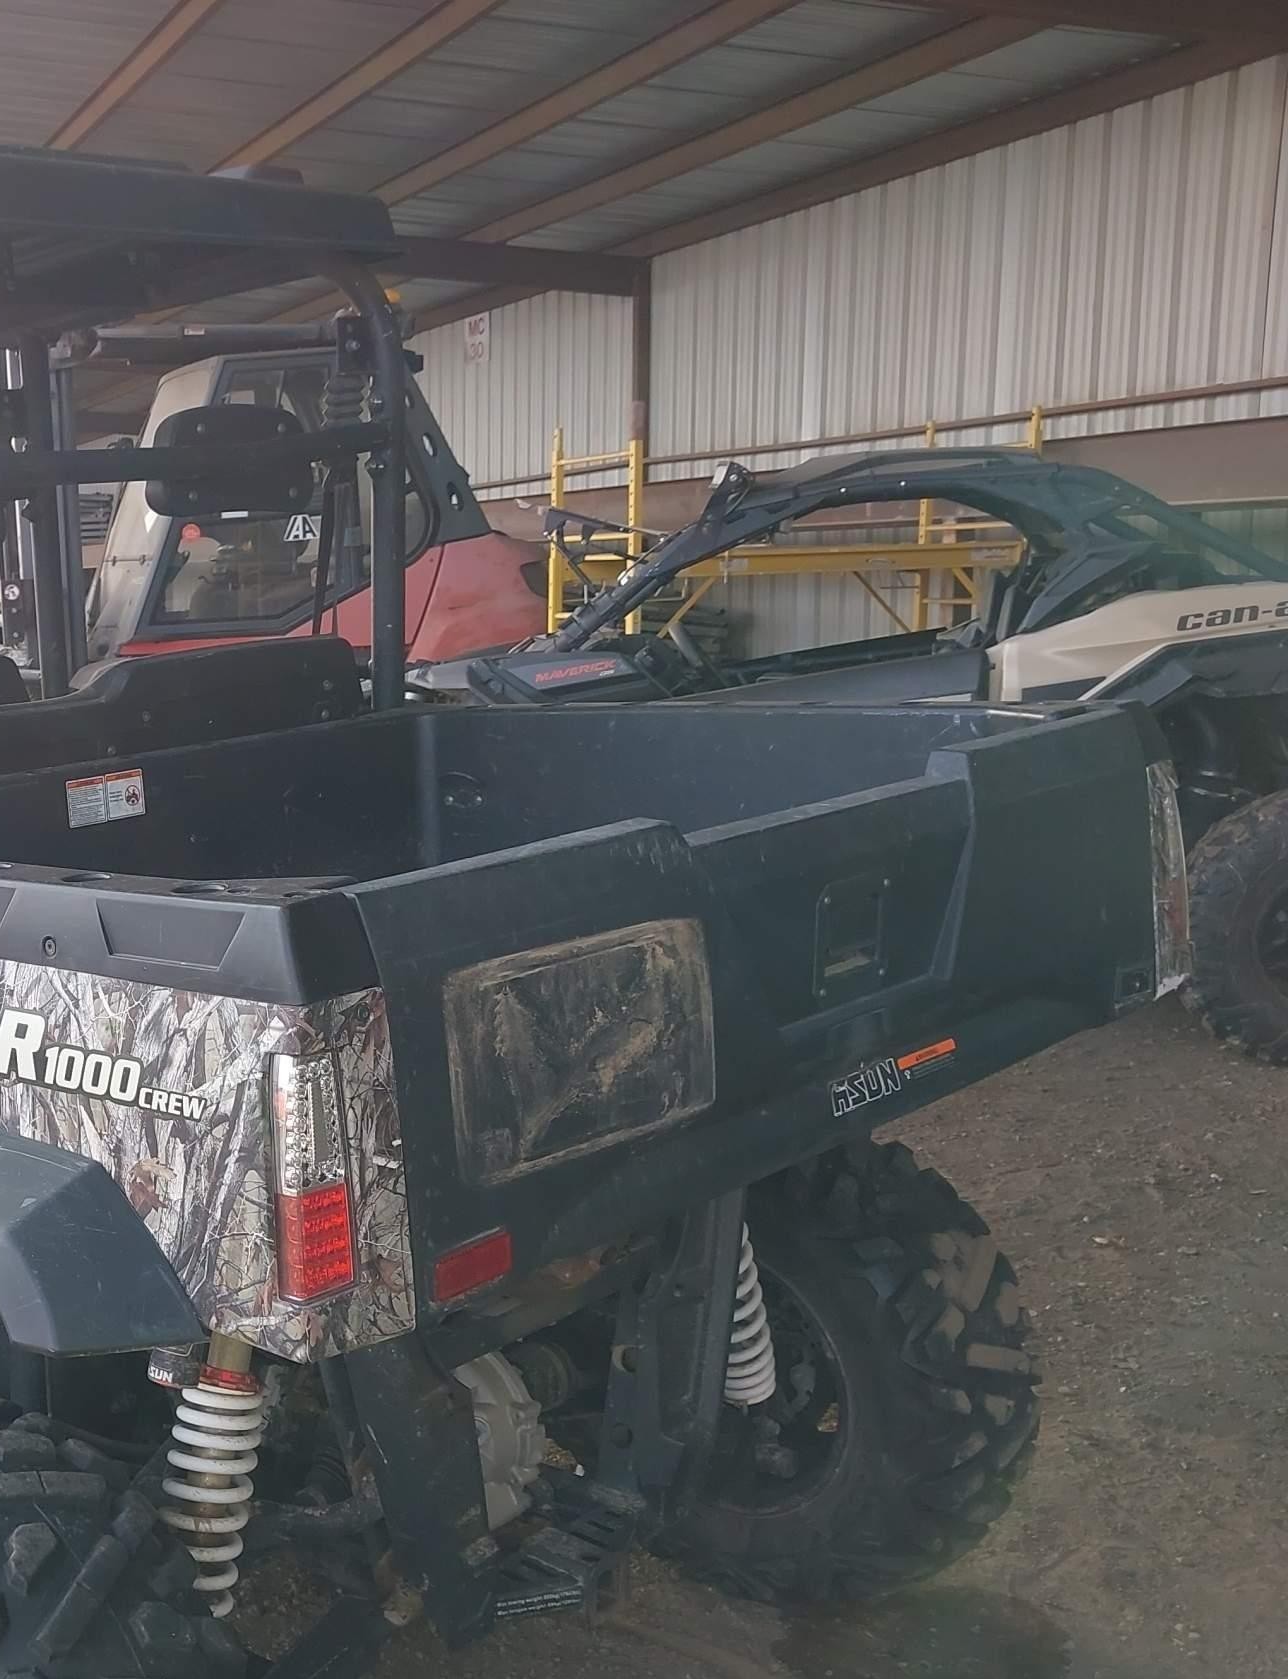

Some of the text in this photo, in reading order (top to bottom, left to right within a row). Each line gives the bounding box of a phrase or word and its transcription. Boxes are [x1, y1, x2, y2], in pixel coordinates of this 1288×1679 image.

[535, 659, 617, 682] MAVERICK
[44, 1046, 141, 1102] 1000
[139, 1088, 206, 1121] CREW
